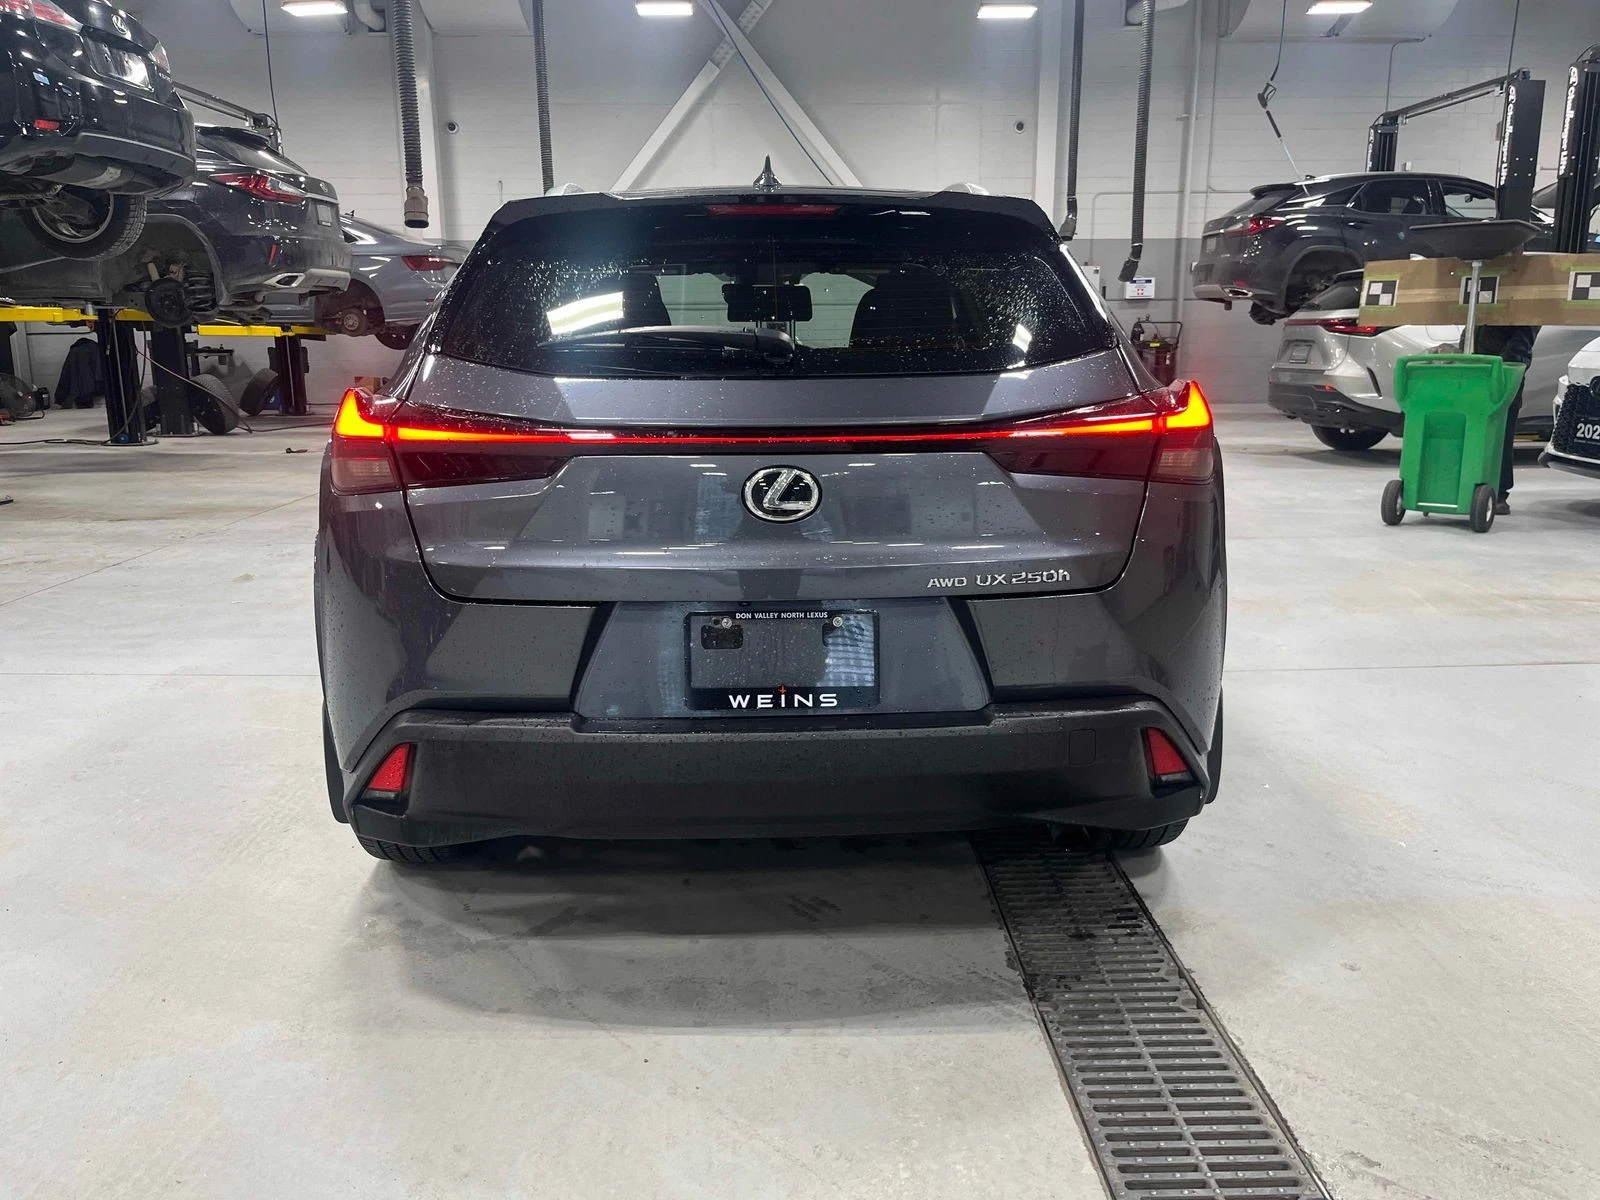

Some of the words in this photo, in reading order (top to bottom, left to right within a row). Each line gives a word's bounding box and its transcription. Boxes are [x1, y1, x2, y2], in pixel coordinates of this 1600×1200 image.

[1561, 86, 1575, 150] Challenger
[927, 577, 967, 588] AWD
[976, 573, 1007, 586] UX
[1011, 569, 1070, 584] 250h
[728, 692, 838, 709] WEINS
